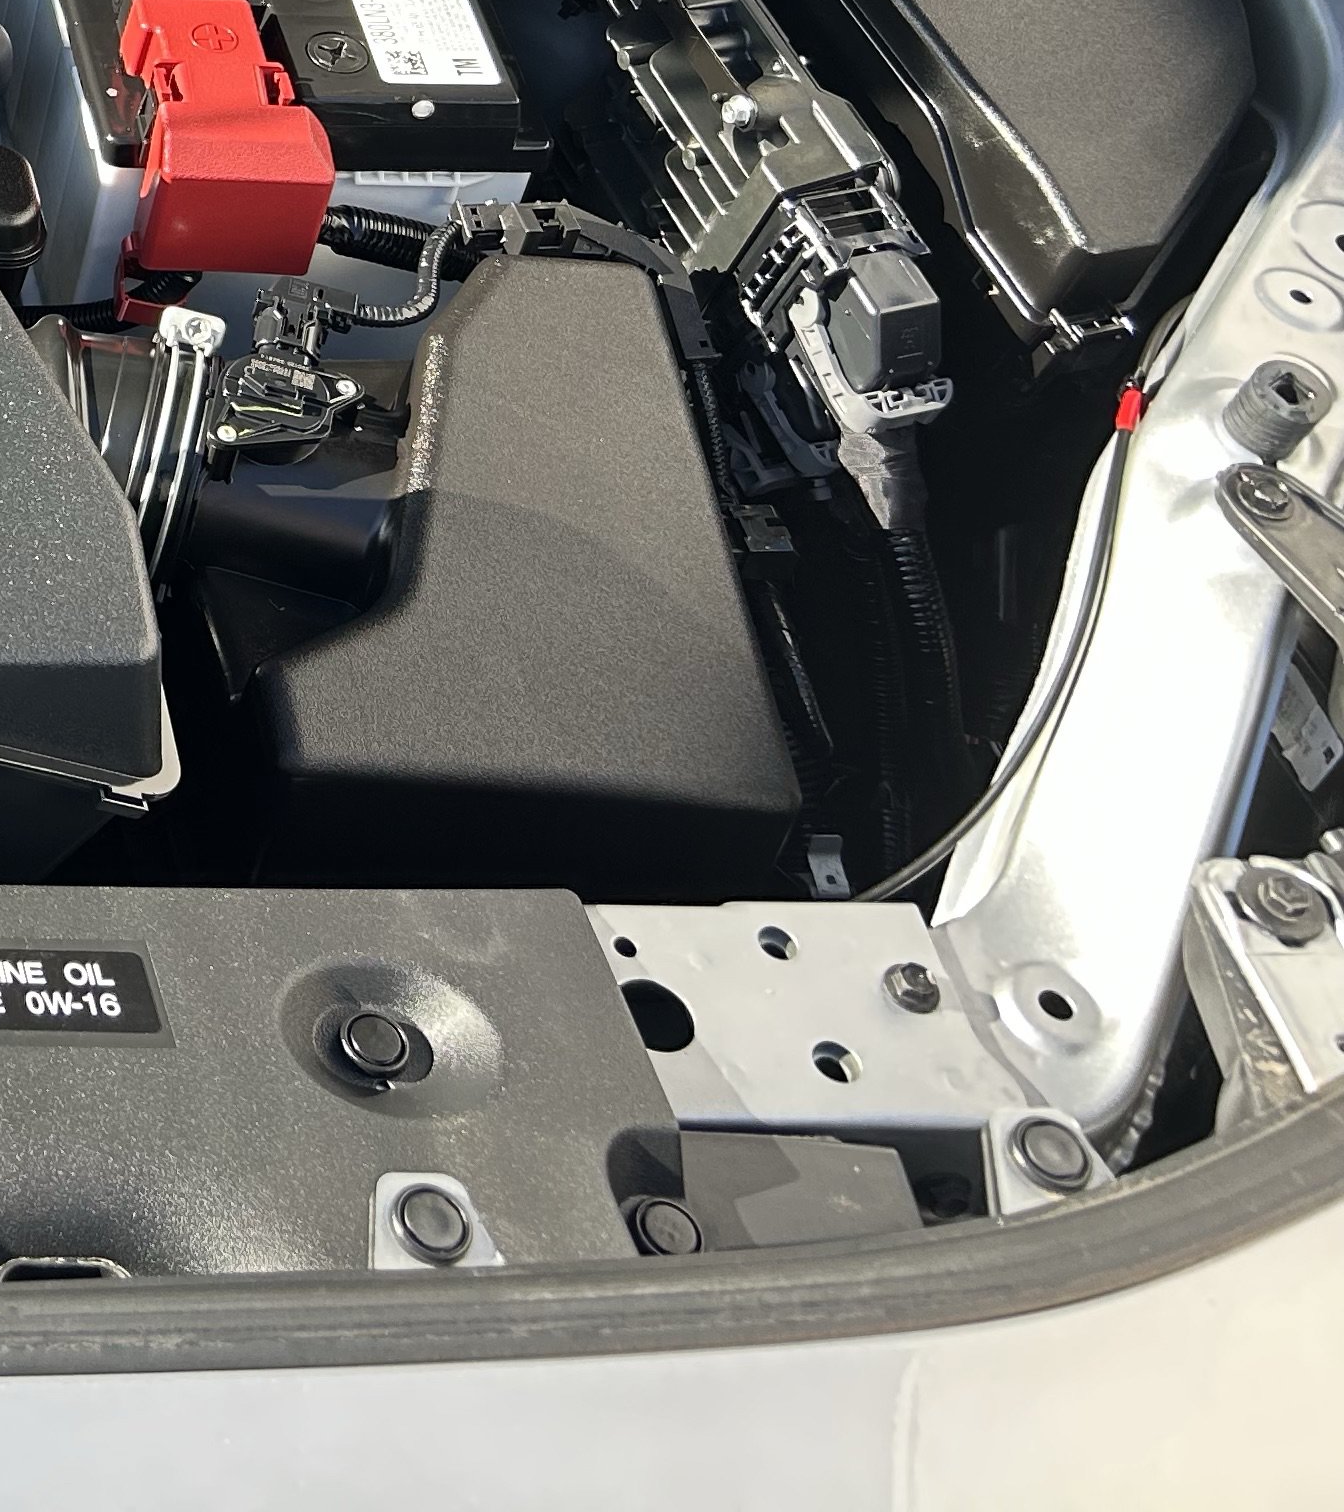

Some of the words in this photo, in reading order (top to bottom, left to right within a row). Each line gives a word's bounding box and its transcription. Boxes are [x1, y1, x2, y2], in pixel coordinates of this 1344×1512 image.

[452, 59, 483, 76] TM
[63, 962, 117, 988] OIL
[25, 991, 122, 1018] 0W-16
